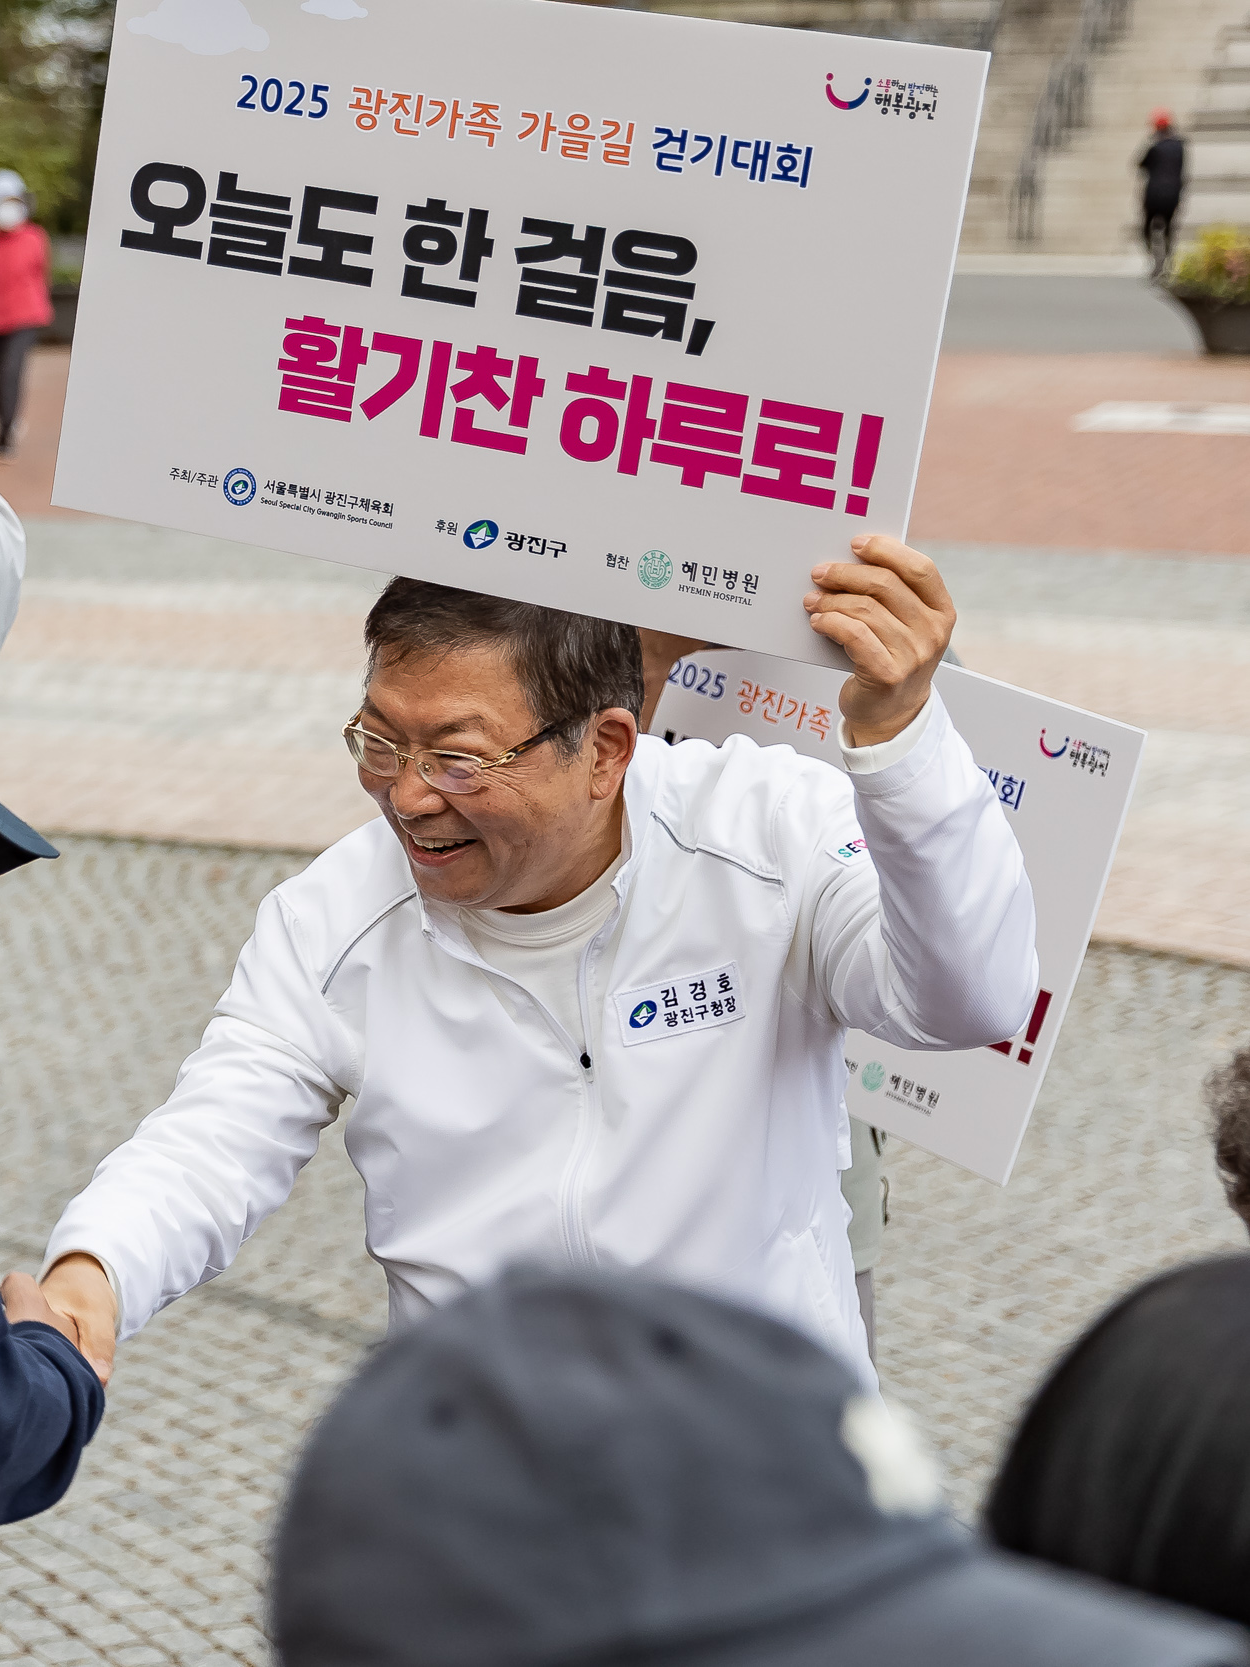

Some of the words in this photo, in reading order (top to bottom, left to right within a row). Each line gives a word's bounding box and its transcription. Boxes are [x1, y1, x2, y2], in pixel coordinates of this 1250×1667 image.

[874, 92, 938, 120] 행복광진
[236, 75, 330, 119] 2025
[348, 85, 503, 149] 광진가족
[516, 111, 637, 167] 가을길
[651, 125, 814, 189] 걷기대회
[120, 161, 379, 288] 오늘도
[401, 197, 494, 309] 한
[515, 217, 716, 357] 걸음,
[277, 314, 546, 455] 활기찬
[559, 365, 885, 517] 하루로!
[169, 467, 219, 488] 주최/주관
[260, 496, 279, 507] Seoul
[279, 500, 302, 512] Special
[302, 505, 316, 515] City
[316, 509, 346, 521] Gwangjin
[347, 514, 368, 526] Sports
[368, 518, 394, 530] Council
[264, 479, 322, 502] 서울특별시
[323, 491, 395, 516] 광진구체육회
[435, 518, 458, 536] 후원
[504, 531, 568, 559] 광진구
[605, 552, 629, 570] 협찬
[681, 560, 760, 595] 혜민병원
[678, 584, 712, 598] HYEMIN
[712, 591, 753, 607] HOSPITAL
[668, 659, 727, 699] 2025
[737, 680, 832, 741] 광진가족
[664, 996, 736, 1027] 광진구청장
